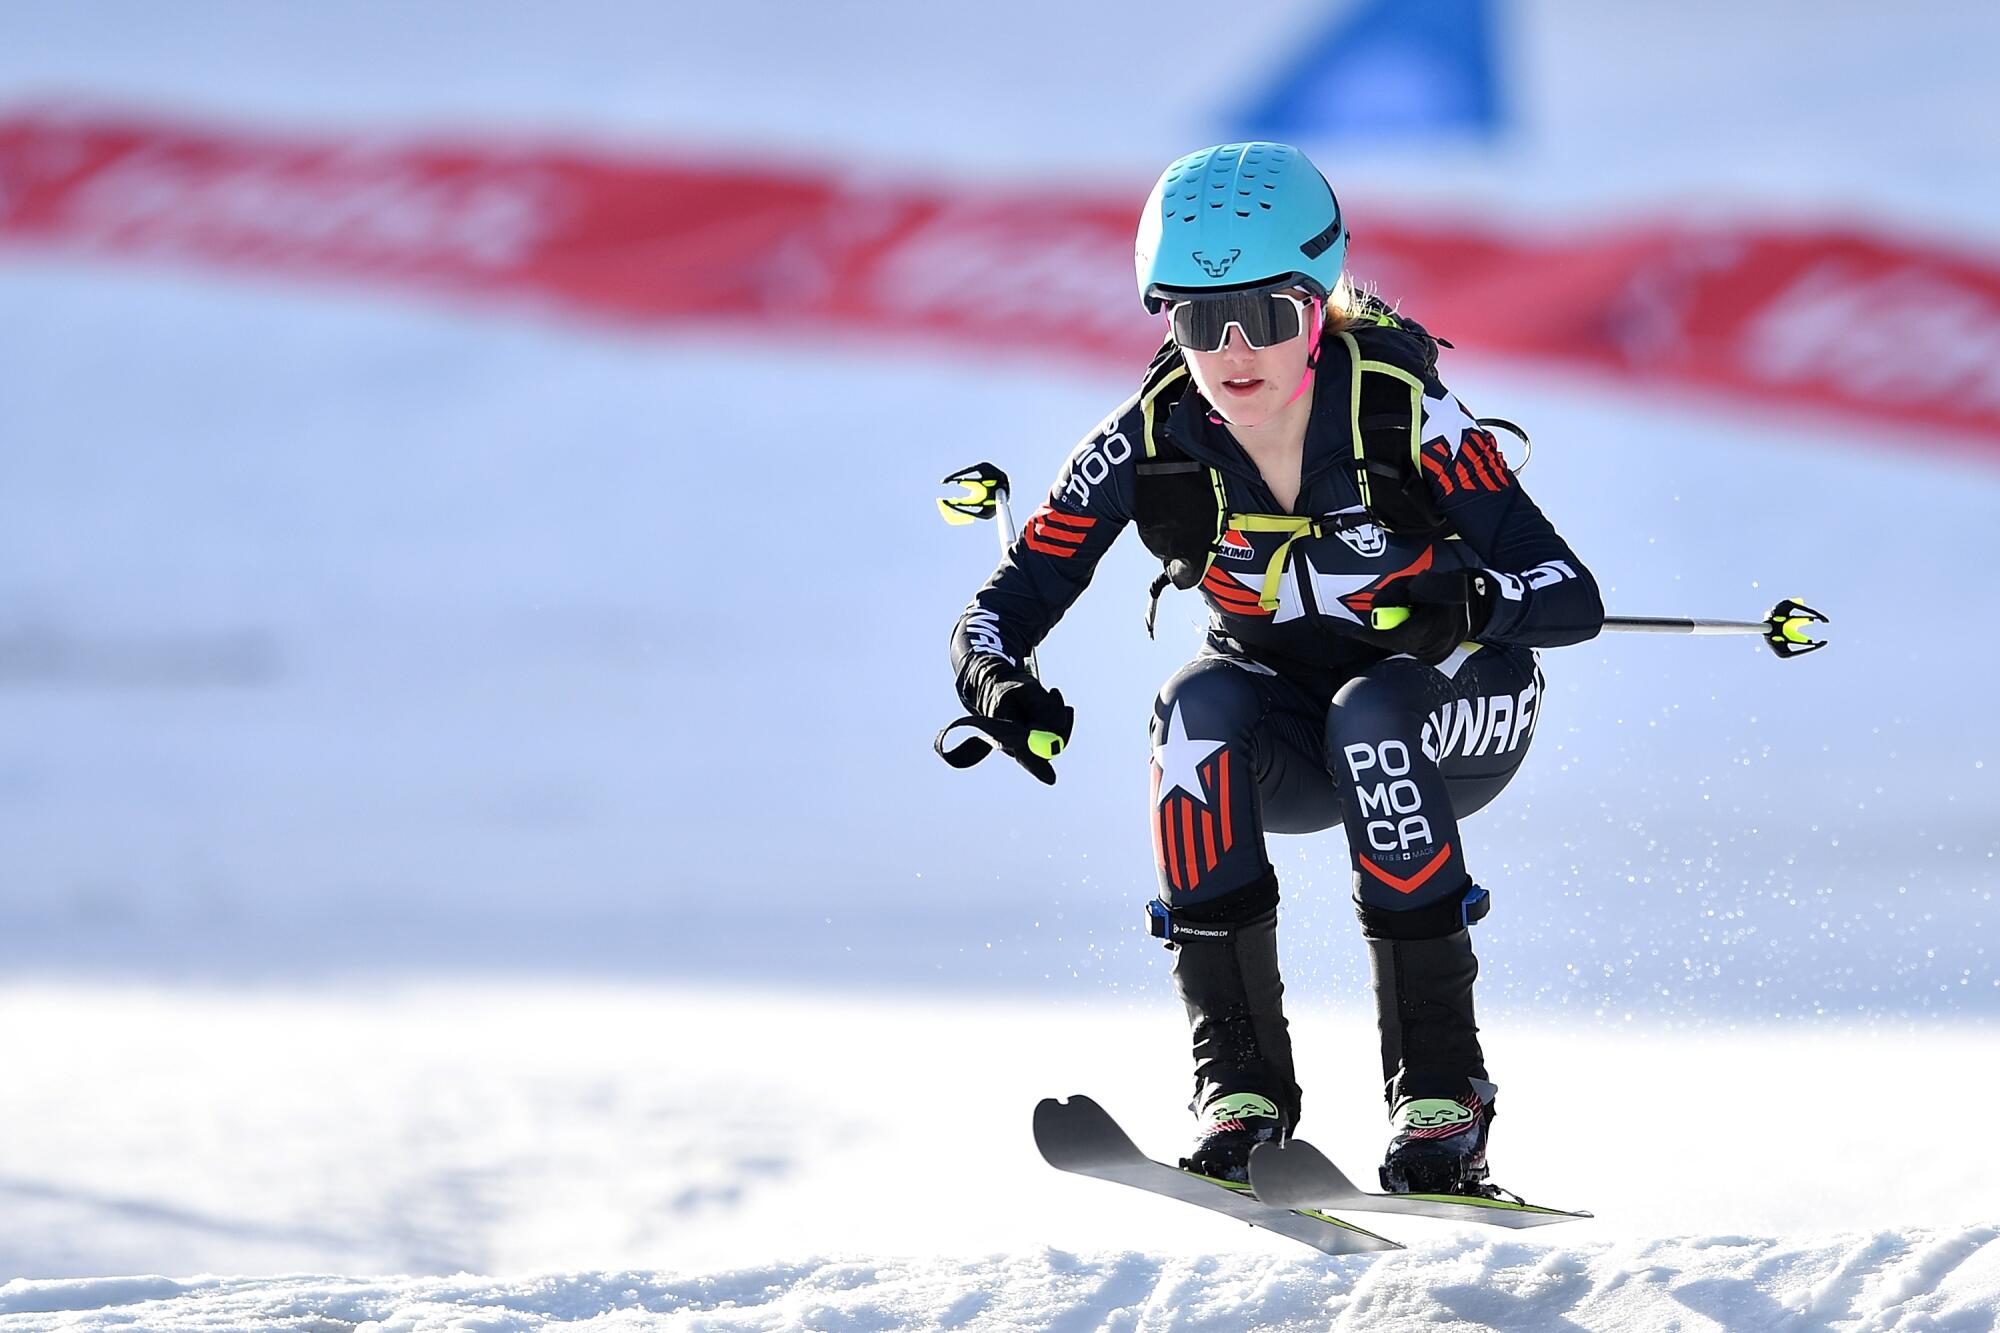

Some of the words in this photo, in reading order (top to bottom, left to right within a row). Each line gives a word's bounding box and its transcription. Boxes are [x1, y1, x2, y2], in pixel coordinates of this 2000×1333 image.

[1218, 544, 1254, 560] SKIMO
[1343, 739, 1411, 782] PO
[1355, 779, 1422, 818] MO
[1366, 814, 1434, 851] CA
